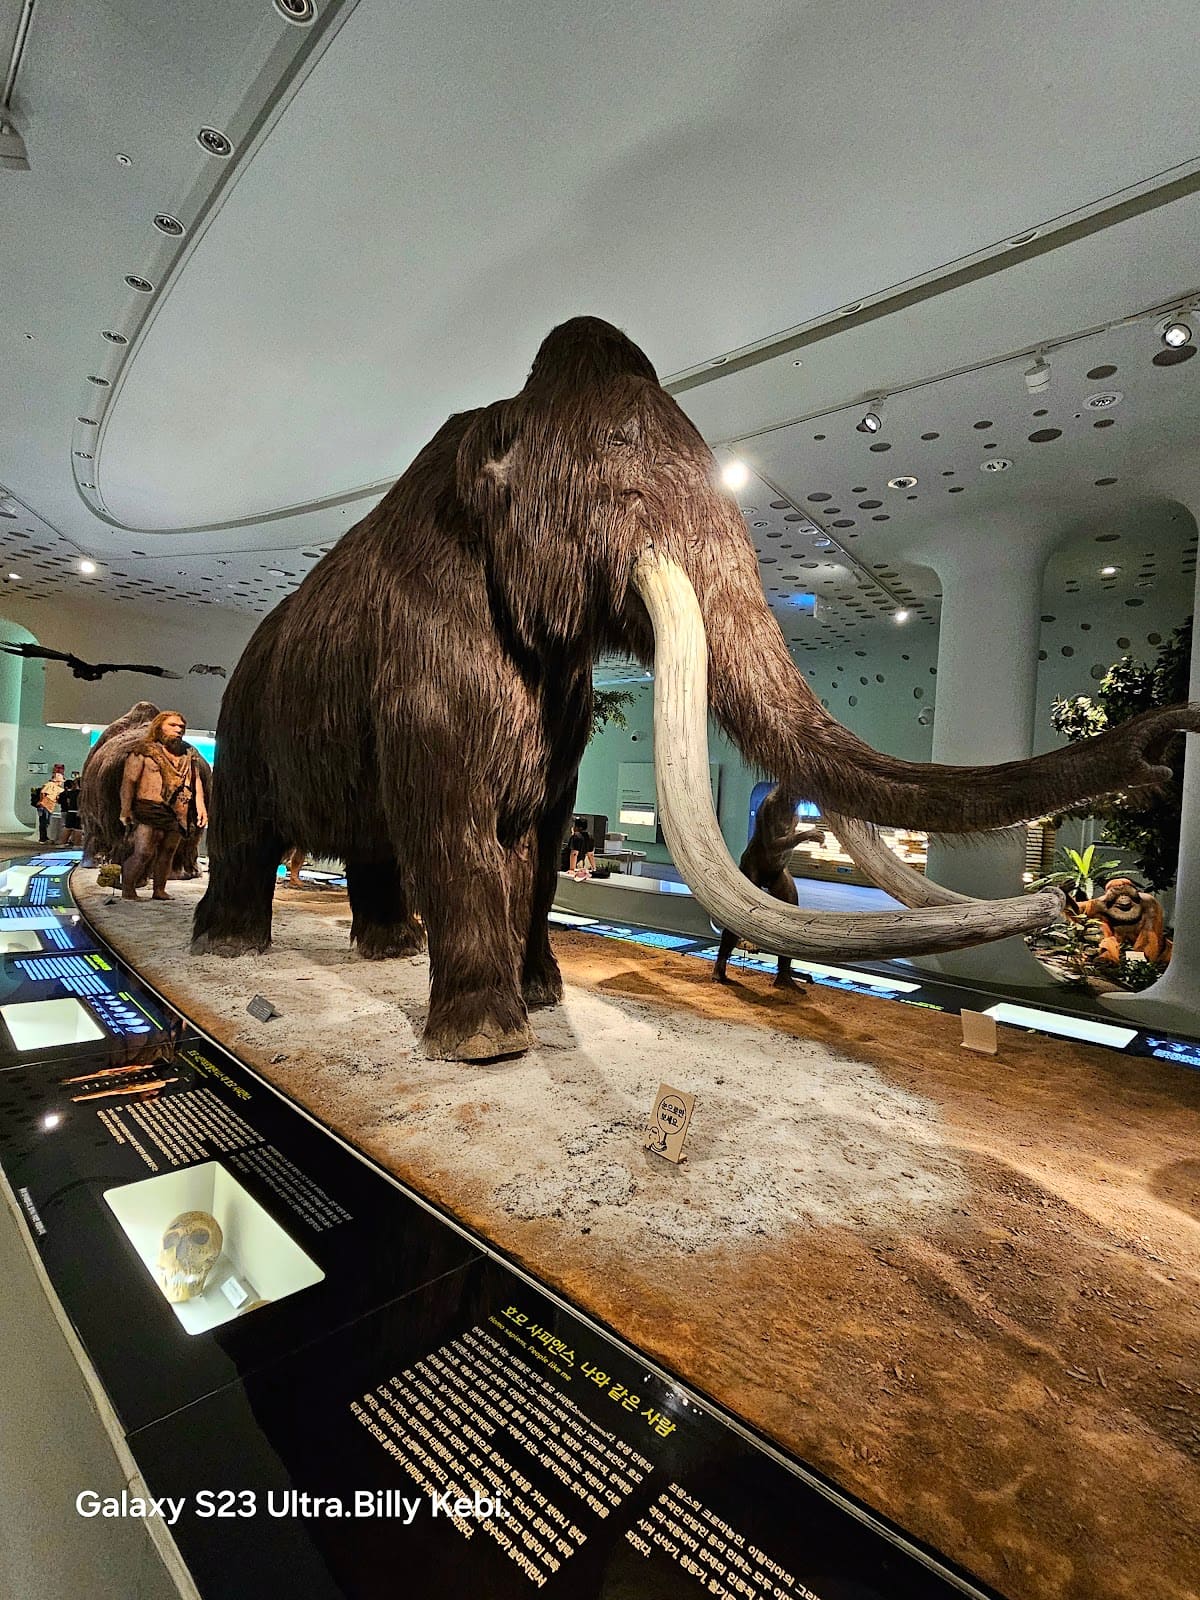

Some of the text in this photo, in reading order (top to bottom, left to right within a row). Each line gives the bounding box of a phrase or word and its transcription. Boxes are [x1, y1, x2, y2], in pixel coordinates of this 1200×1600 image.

[661, 1101, 685, 1118] 눈으로만
[661, 1113, 678, 1127] 보세요
[501, 1306, 676, 1437] 호모 사피엔스, 나와 같은 사람
[625, 1530, 652, 1558] 되었다.
